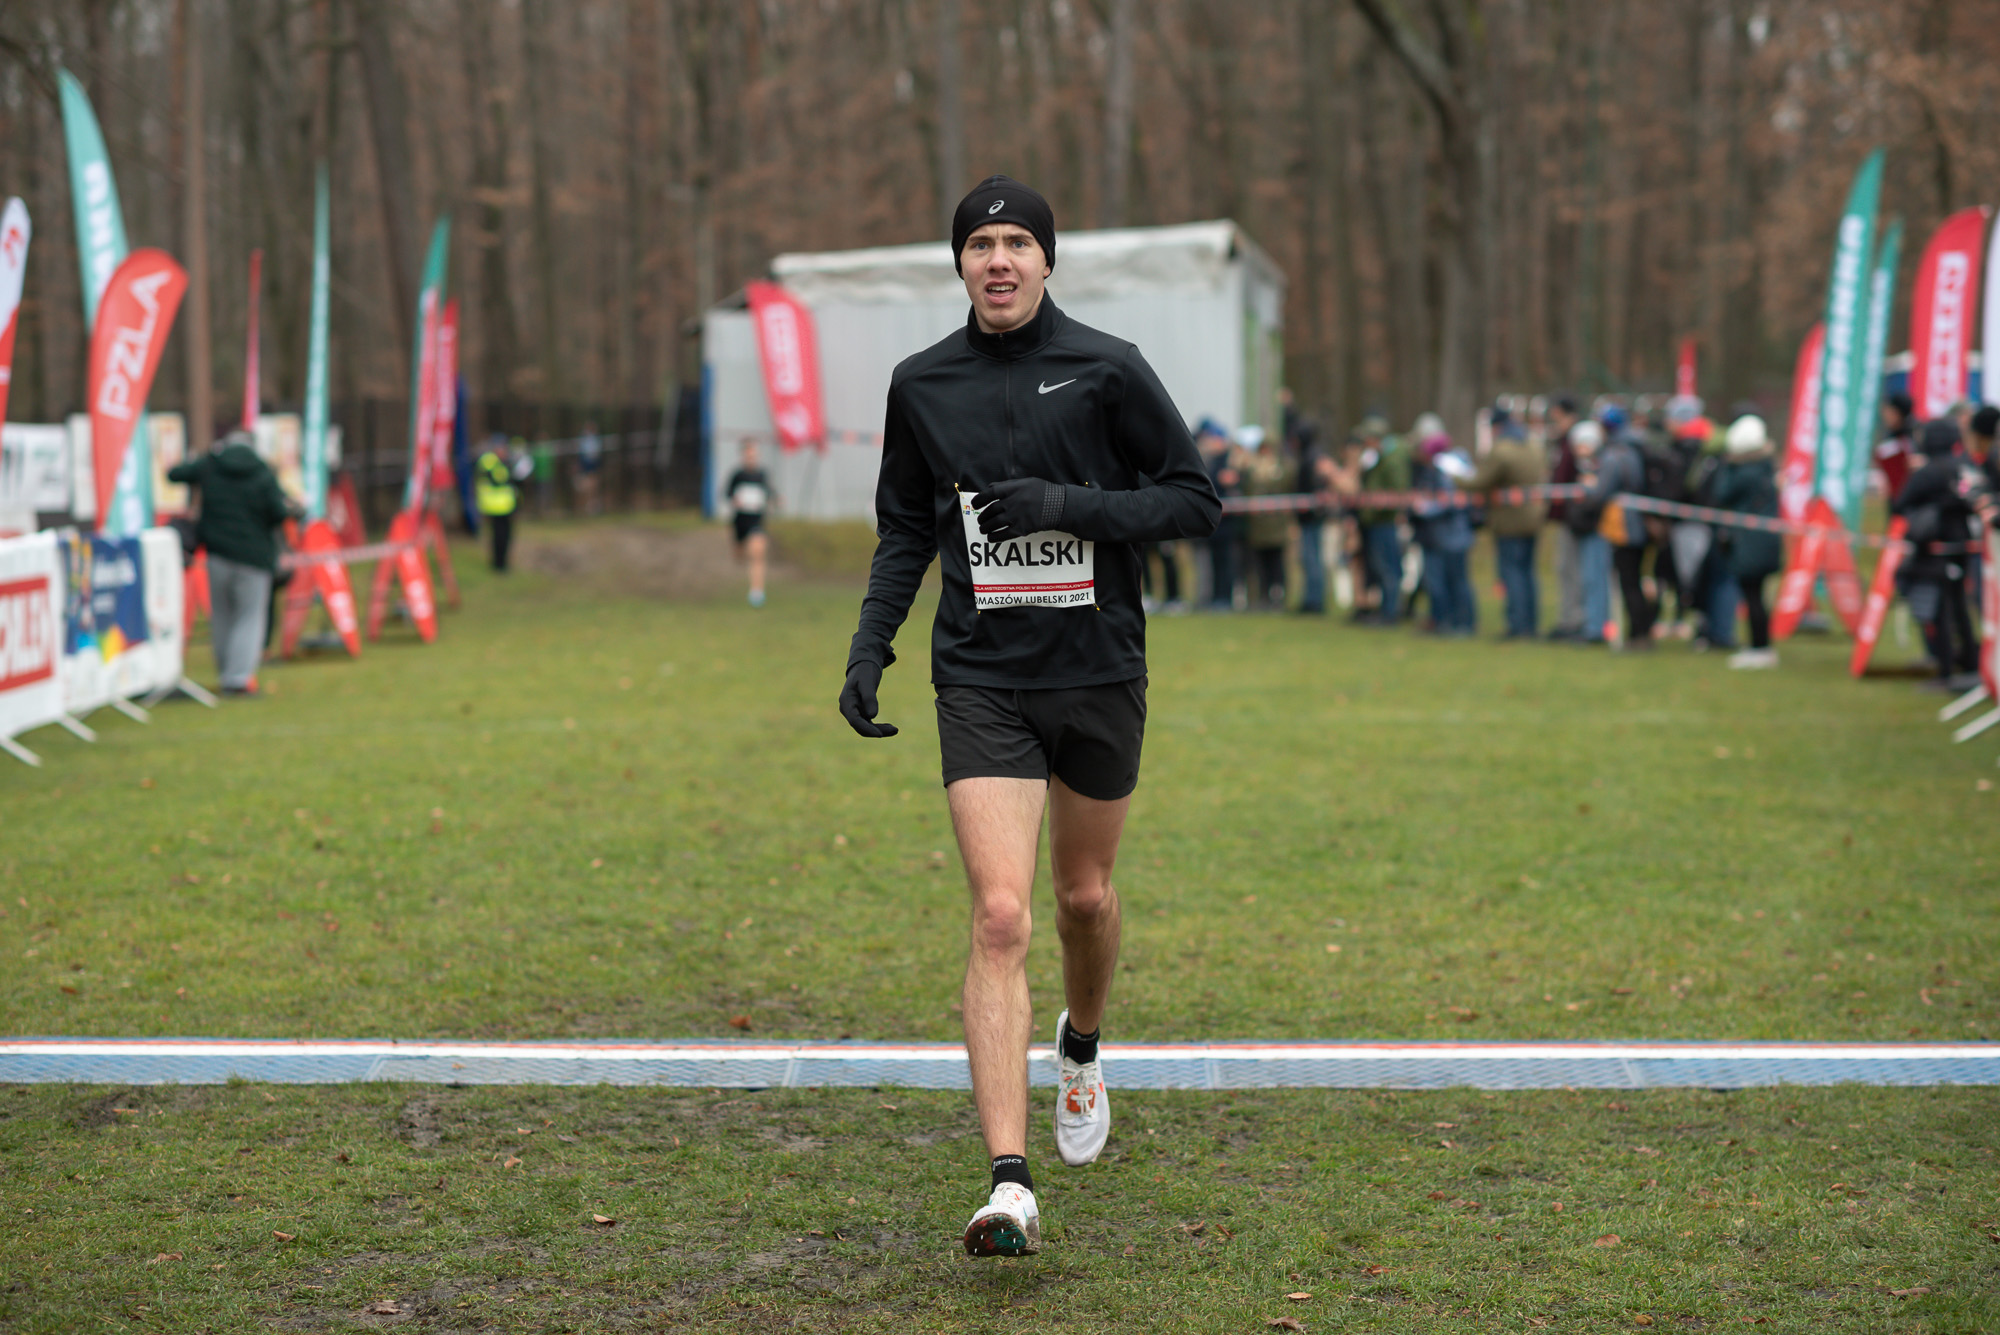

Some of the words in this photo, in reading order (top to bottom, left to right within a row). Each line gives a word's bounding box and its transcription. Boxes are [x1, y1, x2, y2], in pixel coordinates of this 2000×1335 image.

[97, 269, 173, 422] PZLA
[970, 540, 1084, 567] SKALSKI
[1025, 595, 1067, 604] LUBELSKI
[1069, 591, 1090, 603] 2021
